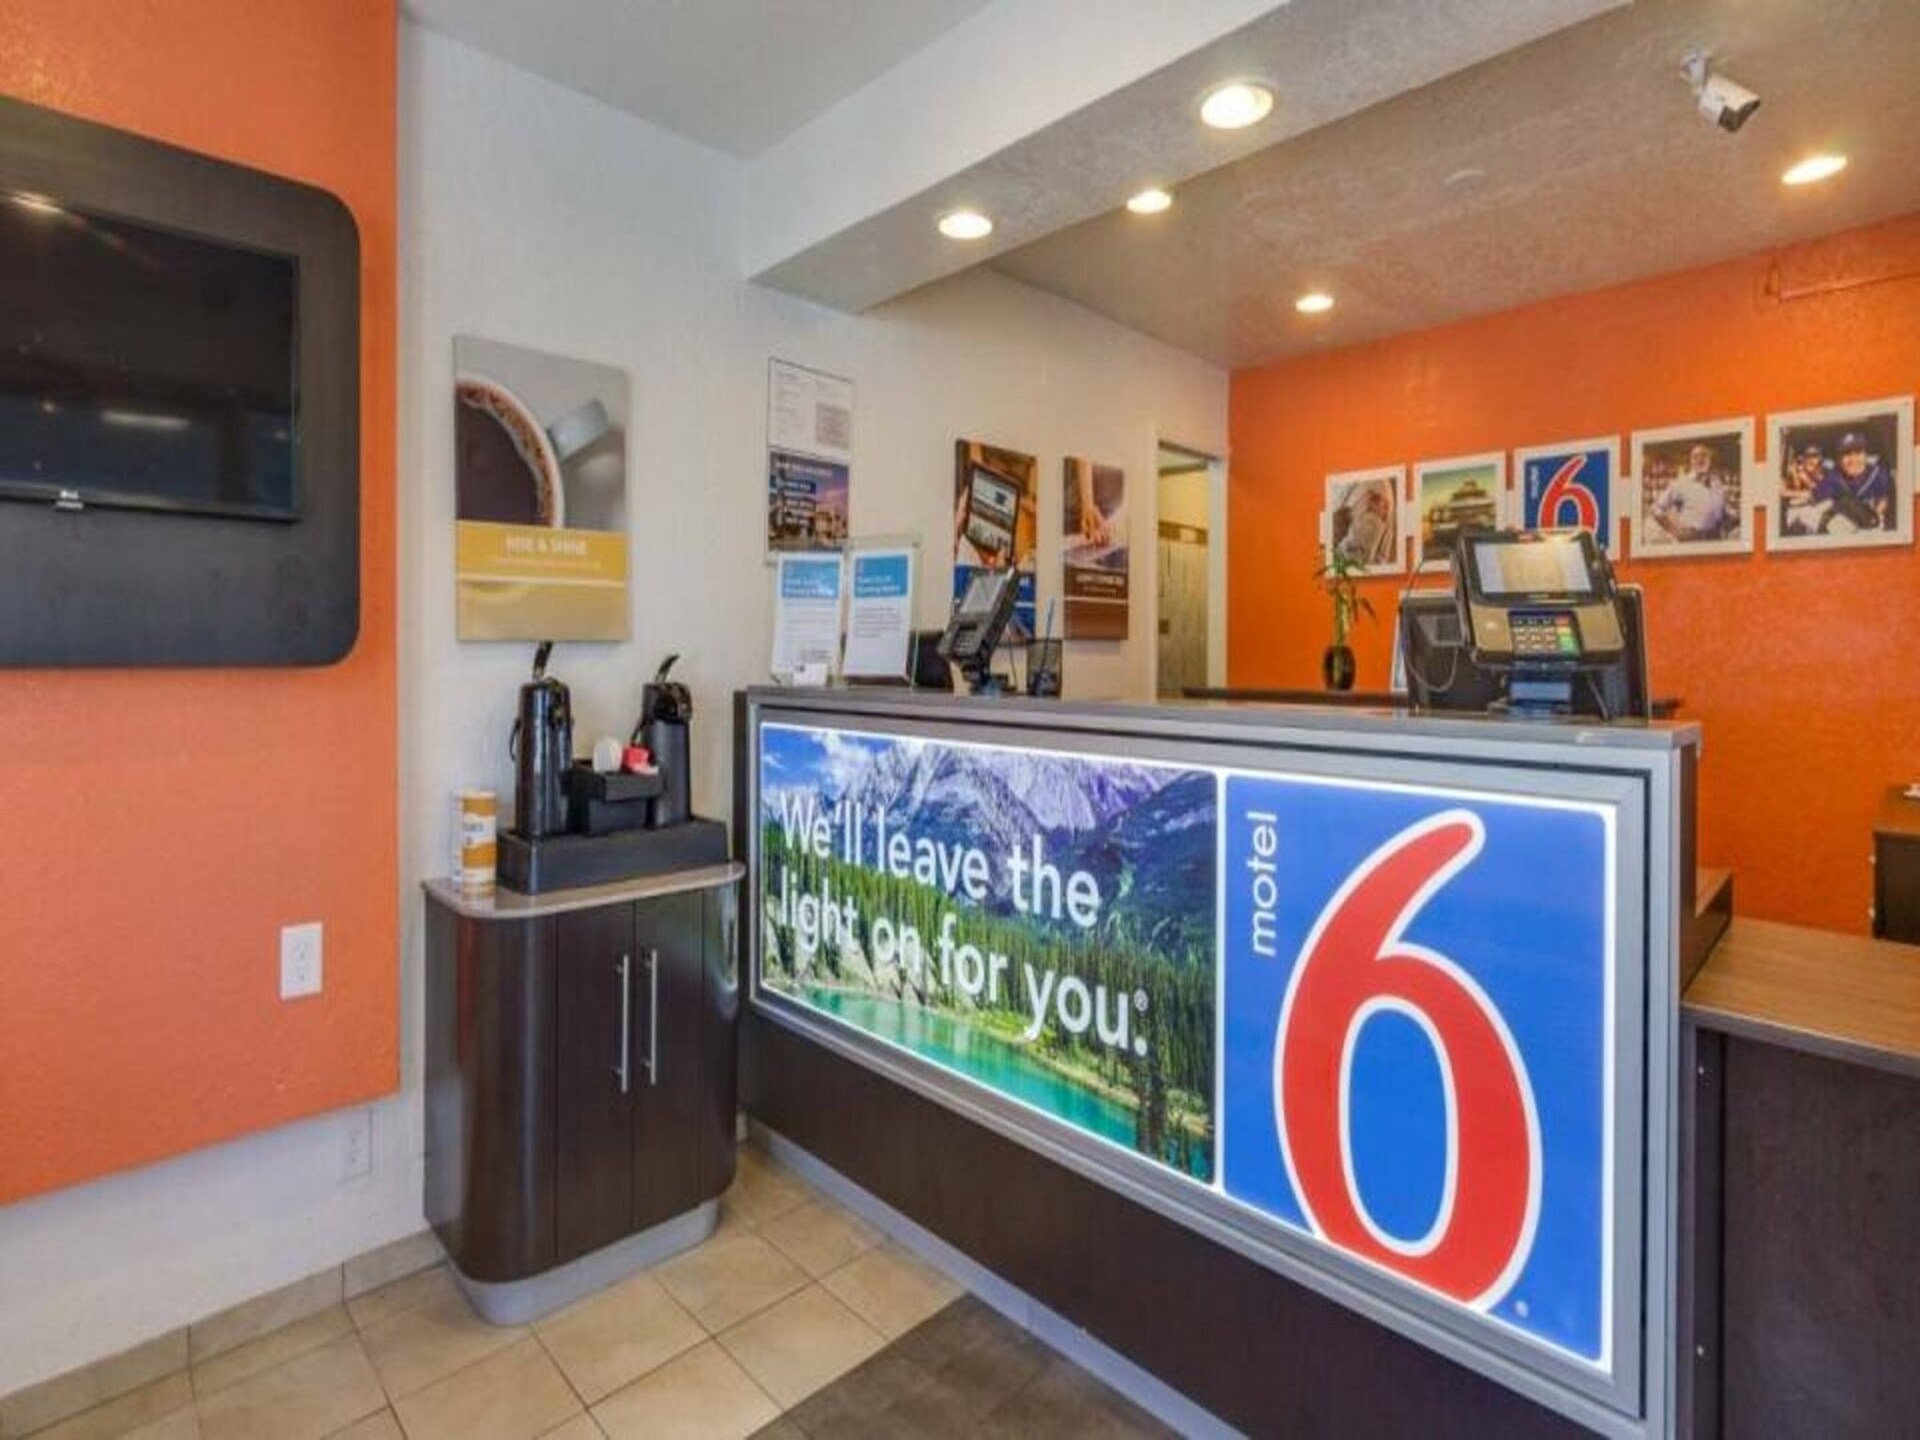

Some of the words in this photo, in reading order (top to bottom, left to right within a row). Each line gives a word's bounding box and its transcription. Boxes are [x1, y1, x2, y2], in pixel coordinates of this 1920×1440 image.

[1537, 455, 1599, 538] 6
[780, 790, 862, 867] We'll
[877, 803, 990, 899] leave
[1007, 833, 1102, 927] the
[1246, 810, 1278, 958] motel
[780, 865, 859, 954] light
[872, 917, 921, 972] on
[938, 912, 1008, 1003] for
[1273, 808, 1543, 1312] 6
